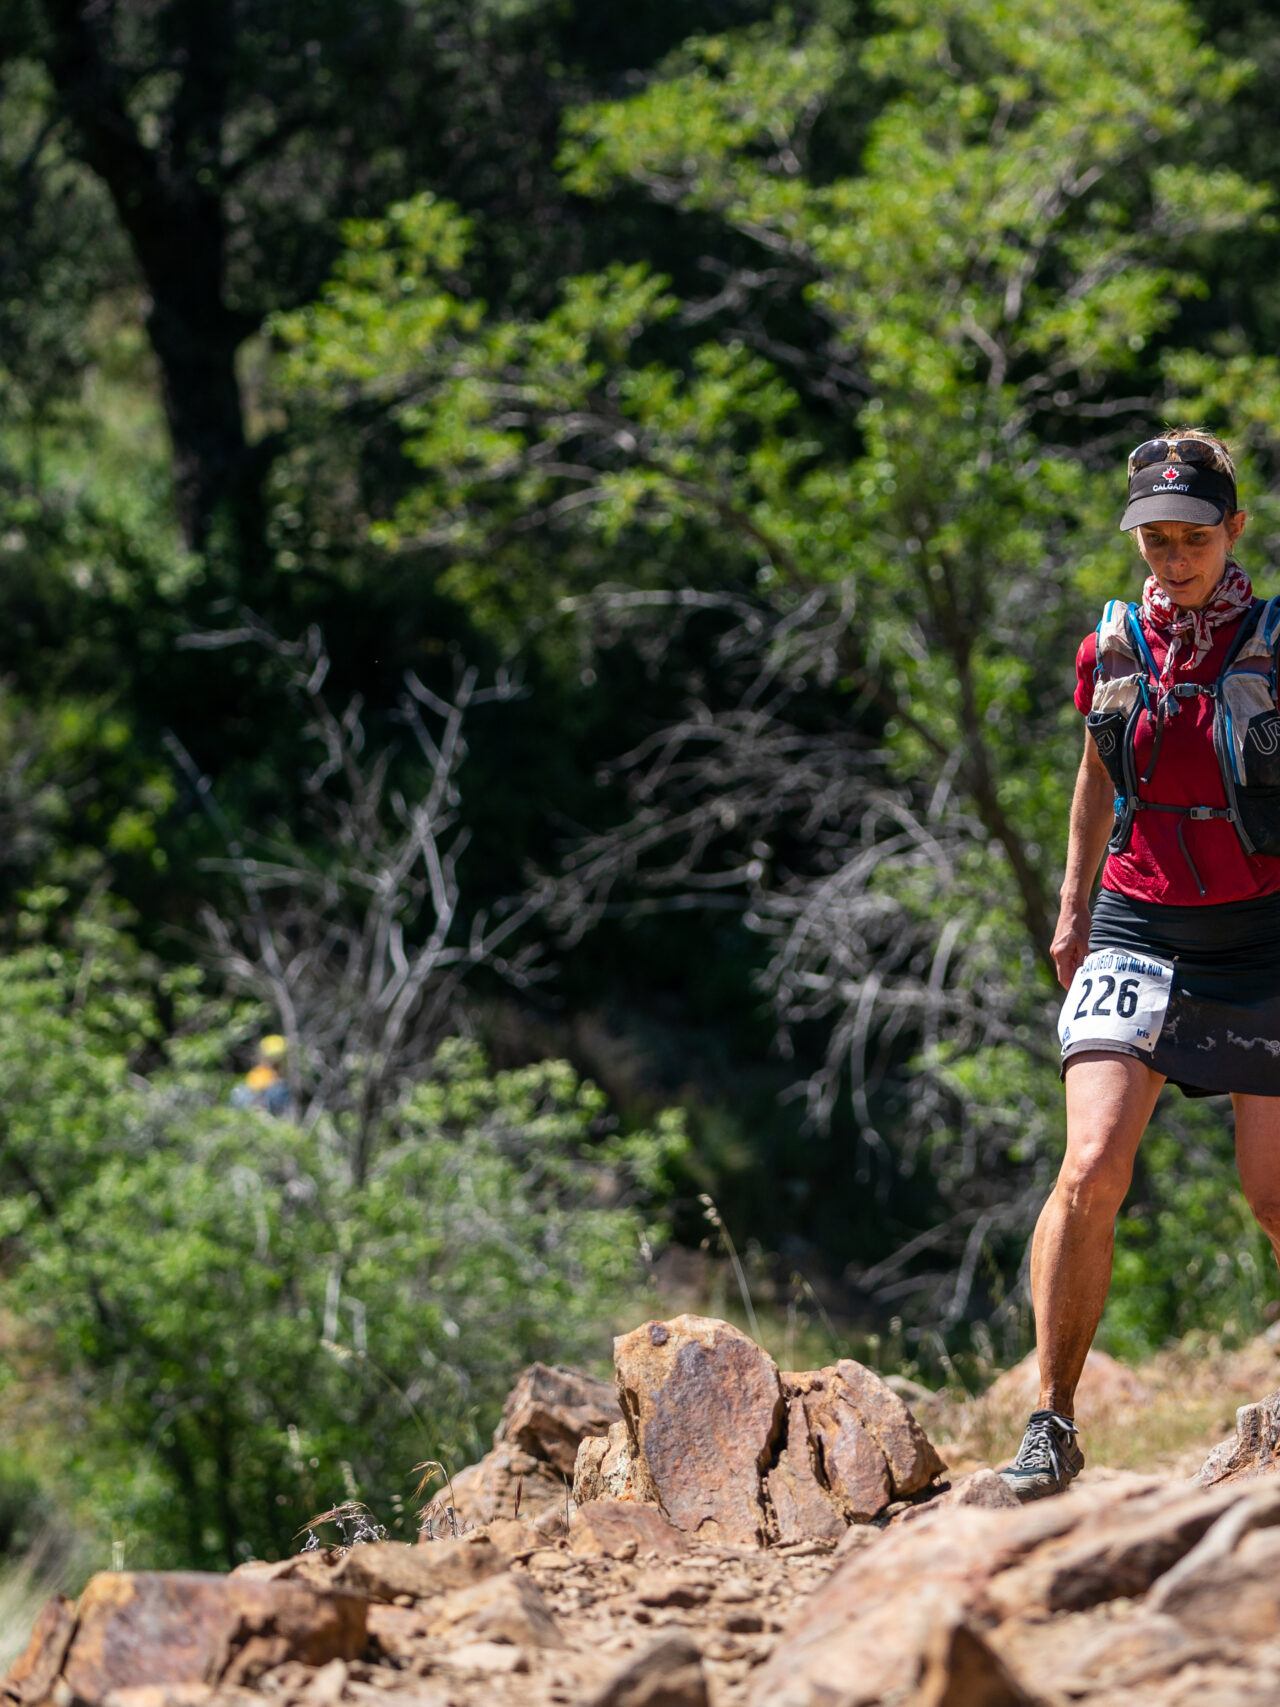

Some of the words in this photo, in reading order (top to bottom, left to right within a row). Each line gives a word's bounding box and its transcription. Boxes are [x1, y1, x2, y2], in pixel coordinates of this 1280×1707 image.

[1153, 483, 1189, 492] CALGARY
[1115, 956, 1128, 972] 100
[1128, 957, 1146, 973] MILE
[1147, 963, 1162, 976] RUN
[1073, 975, 1140, 1021] 226
[1137, 1028, 1150, 1039] Iris
